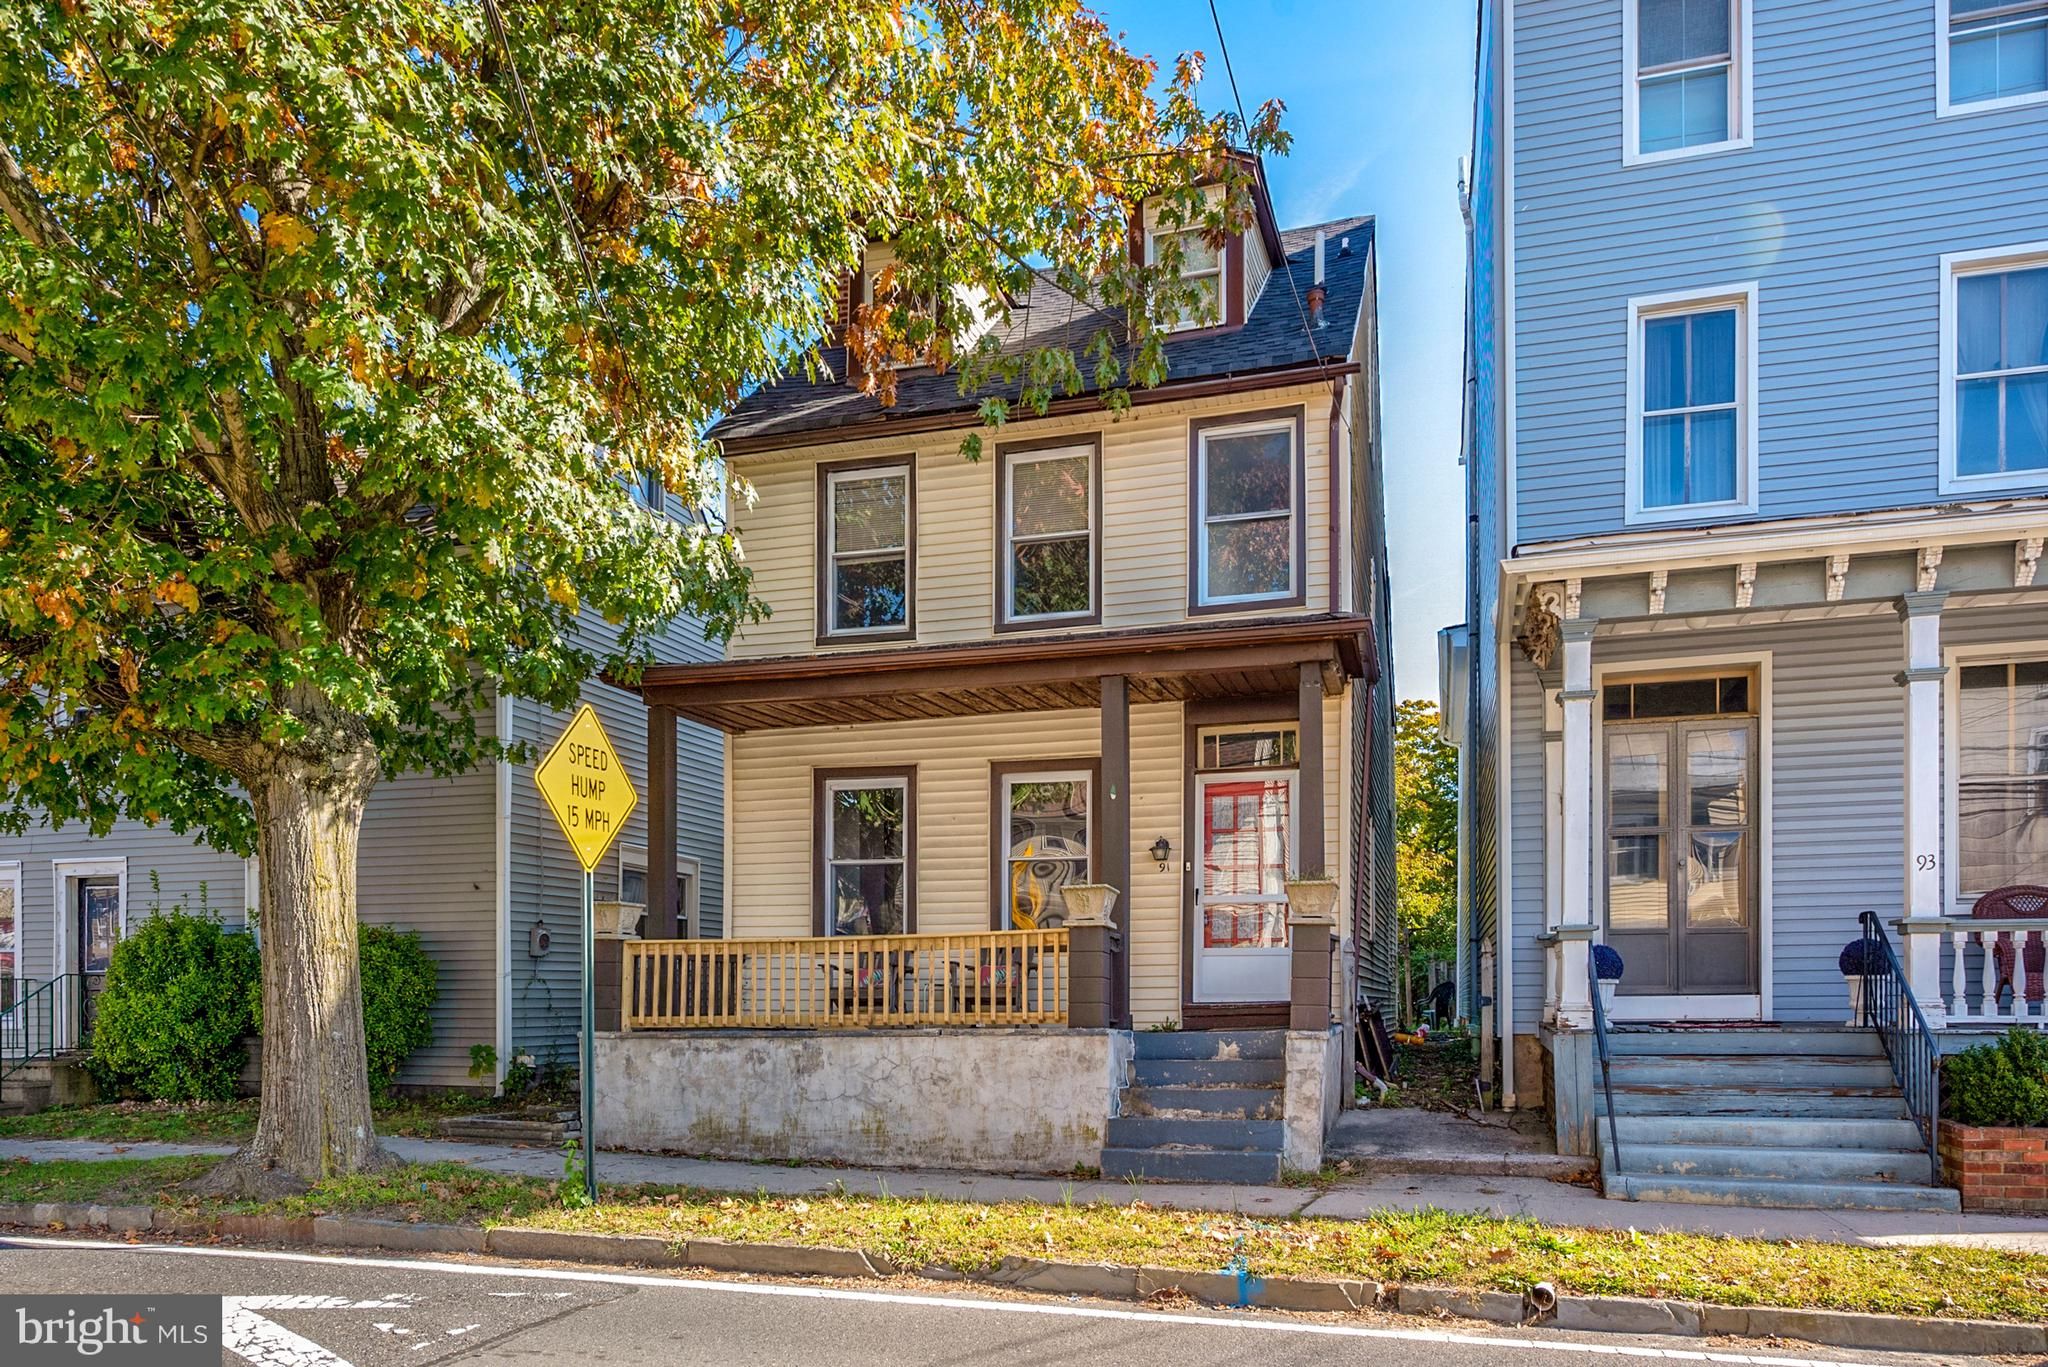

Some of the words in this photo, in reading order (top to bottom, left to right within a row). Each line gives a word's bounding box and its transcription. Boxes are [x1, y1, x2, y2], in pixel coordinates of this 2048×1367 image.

[569, 742, 608, 771] SPEED
[571, 774, 606, 801] HUMP
[567, 805, 580, 827] 15
[585, 807, 610, 833] MPH
[1159, 863, 1170, 872] 91
[1916, 854, 1936, 871] 93
